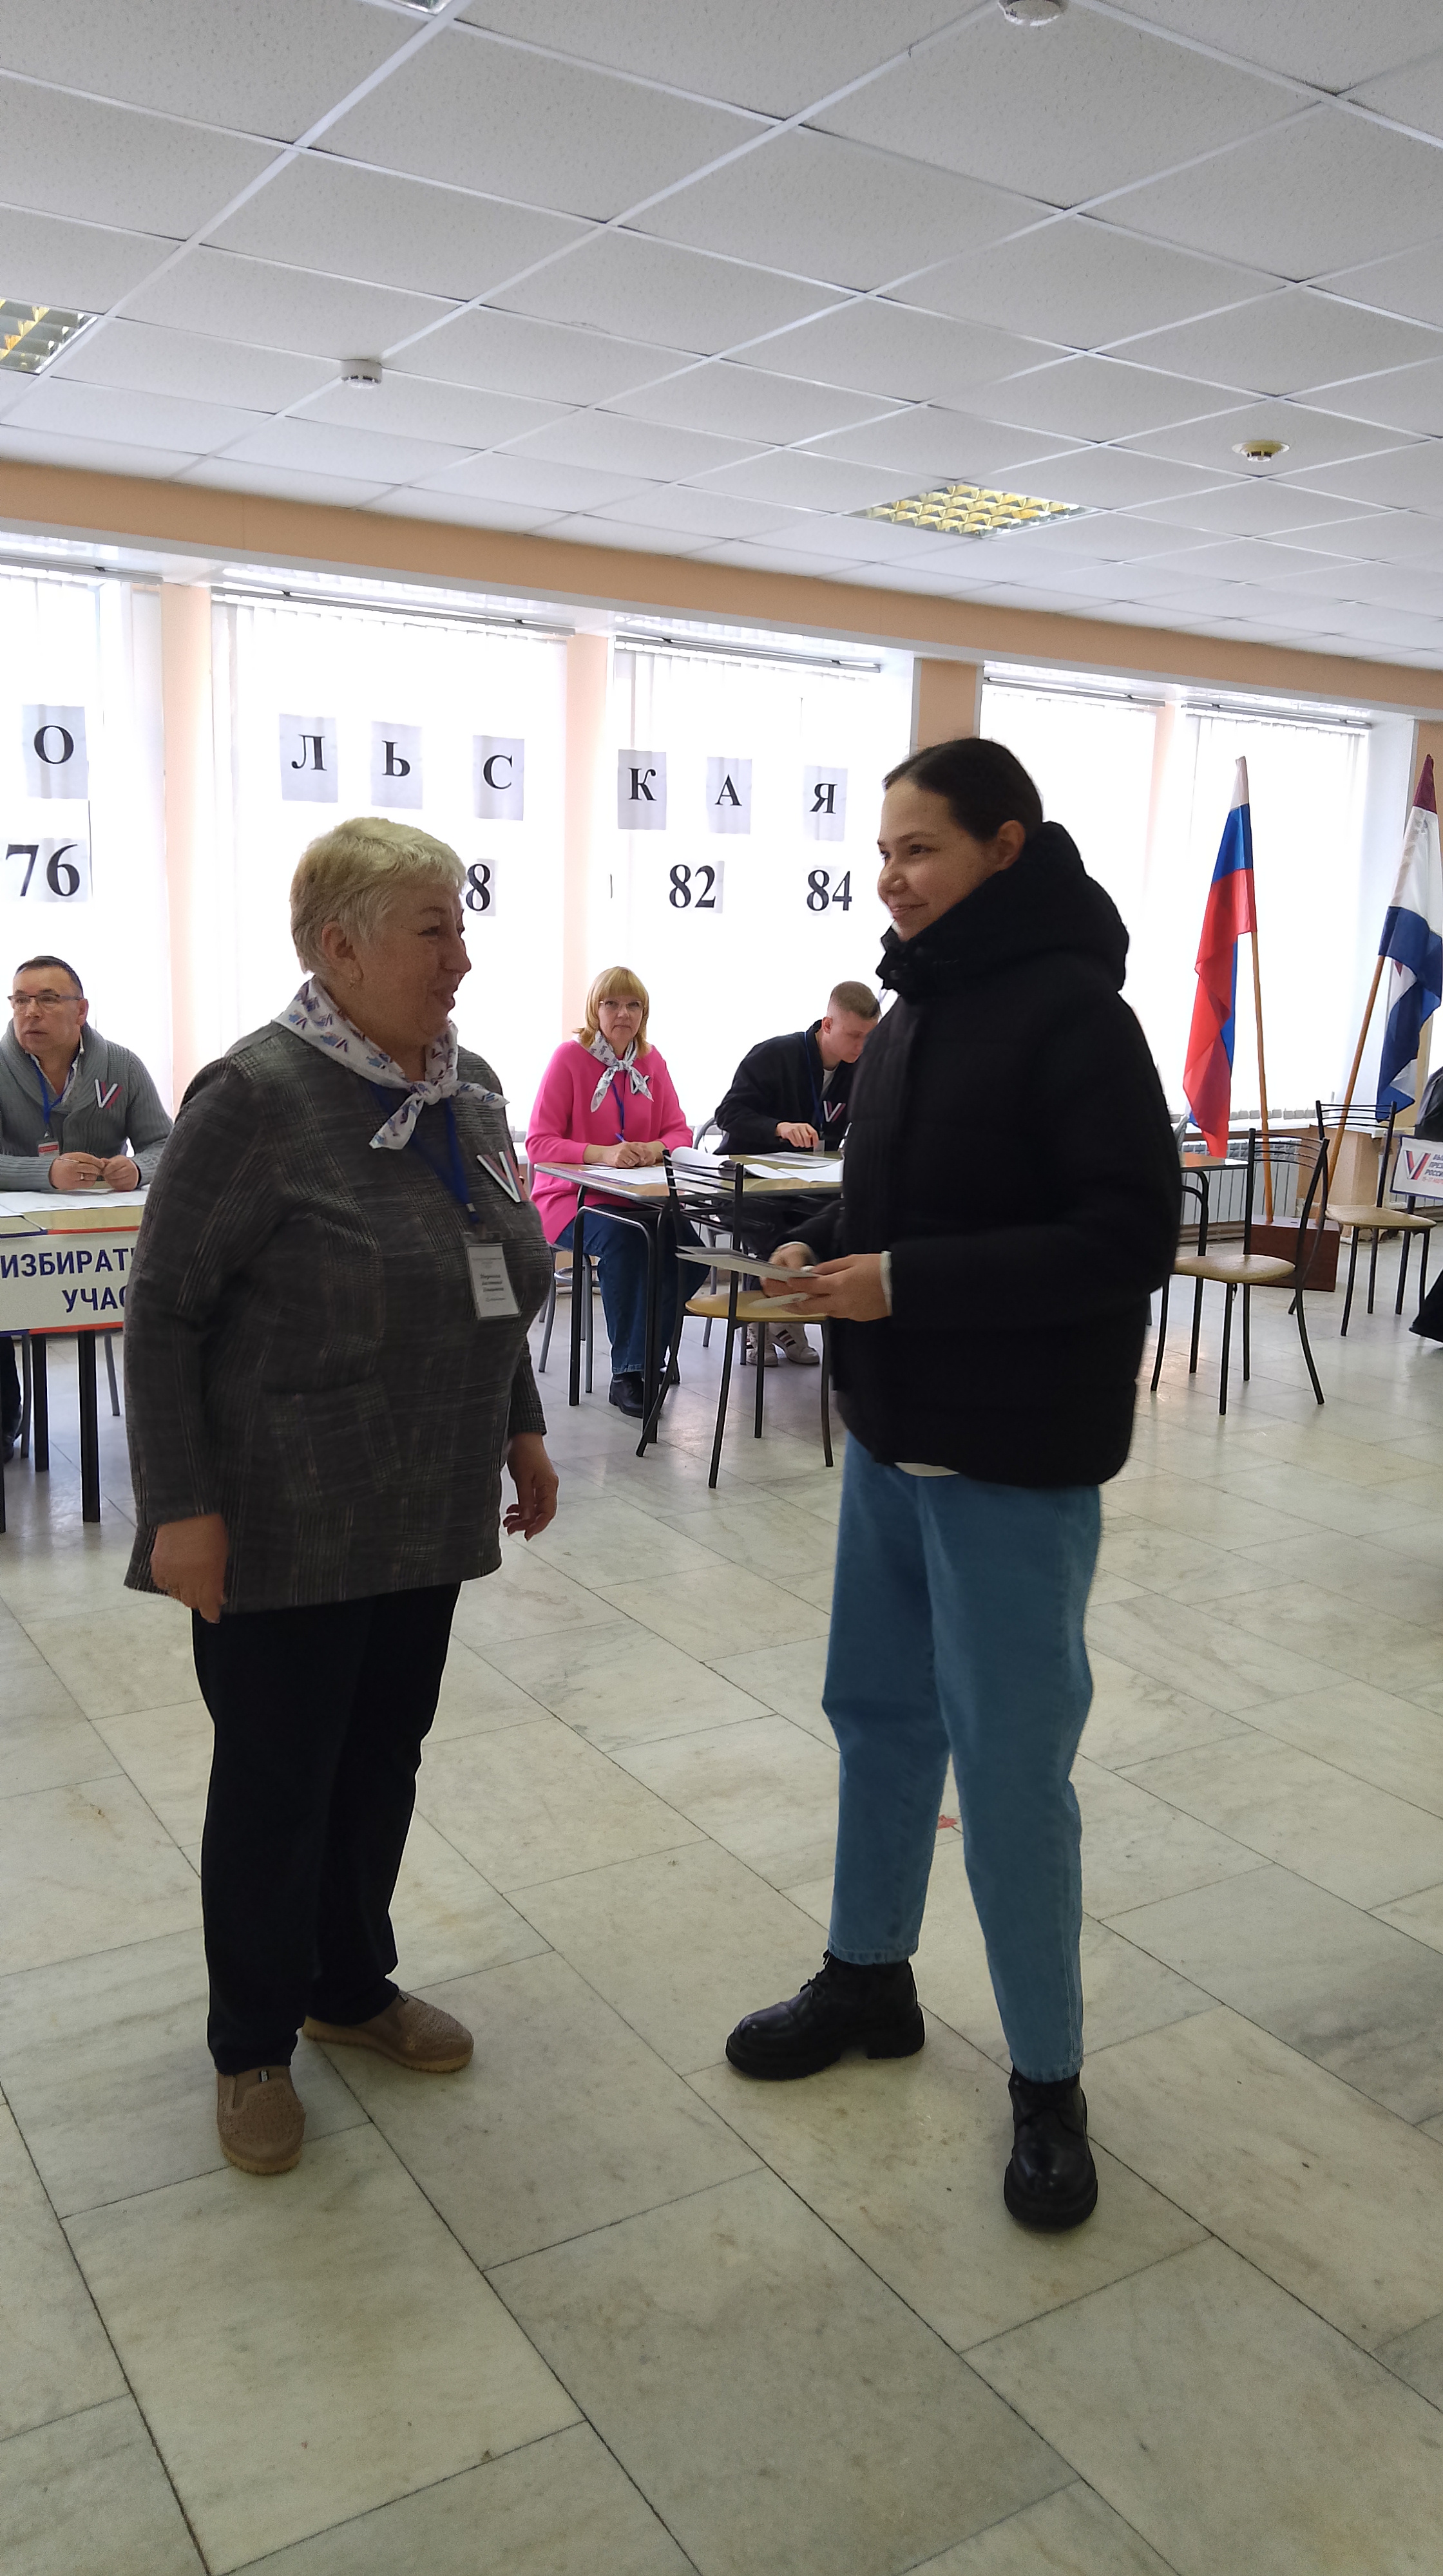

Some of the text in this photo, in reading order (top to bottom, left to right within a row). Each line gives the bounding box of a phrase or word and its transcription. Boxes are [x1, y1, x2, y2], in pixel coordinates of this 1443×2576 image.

[291, 735, 326, 771] Л
[628, 767, 657, 801] К
[715, 774, 742, 806] А
[810, 783, 837, 814] Я
[5, 844, 852, 912] 76 8 82 84
